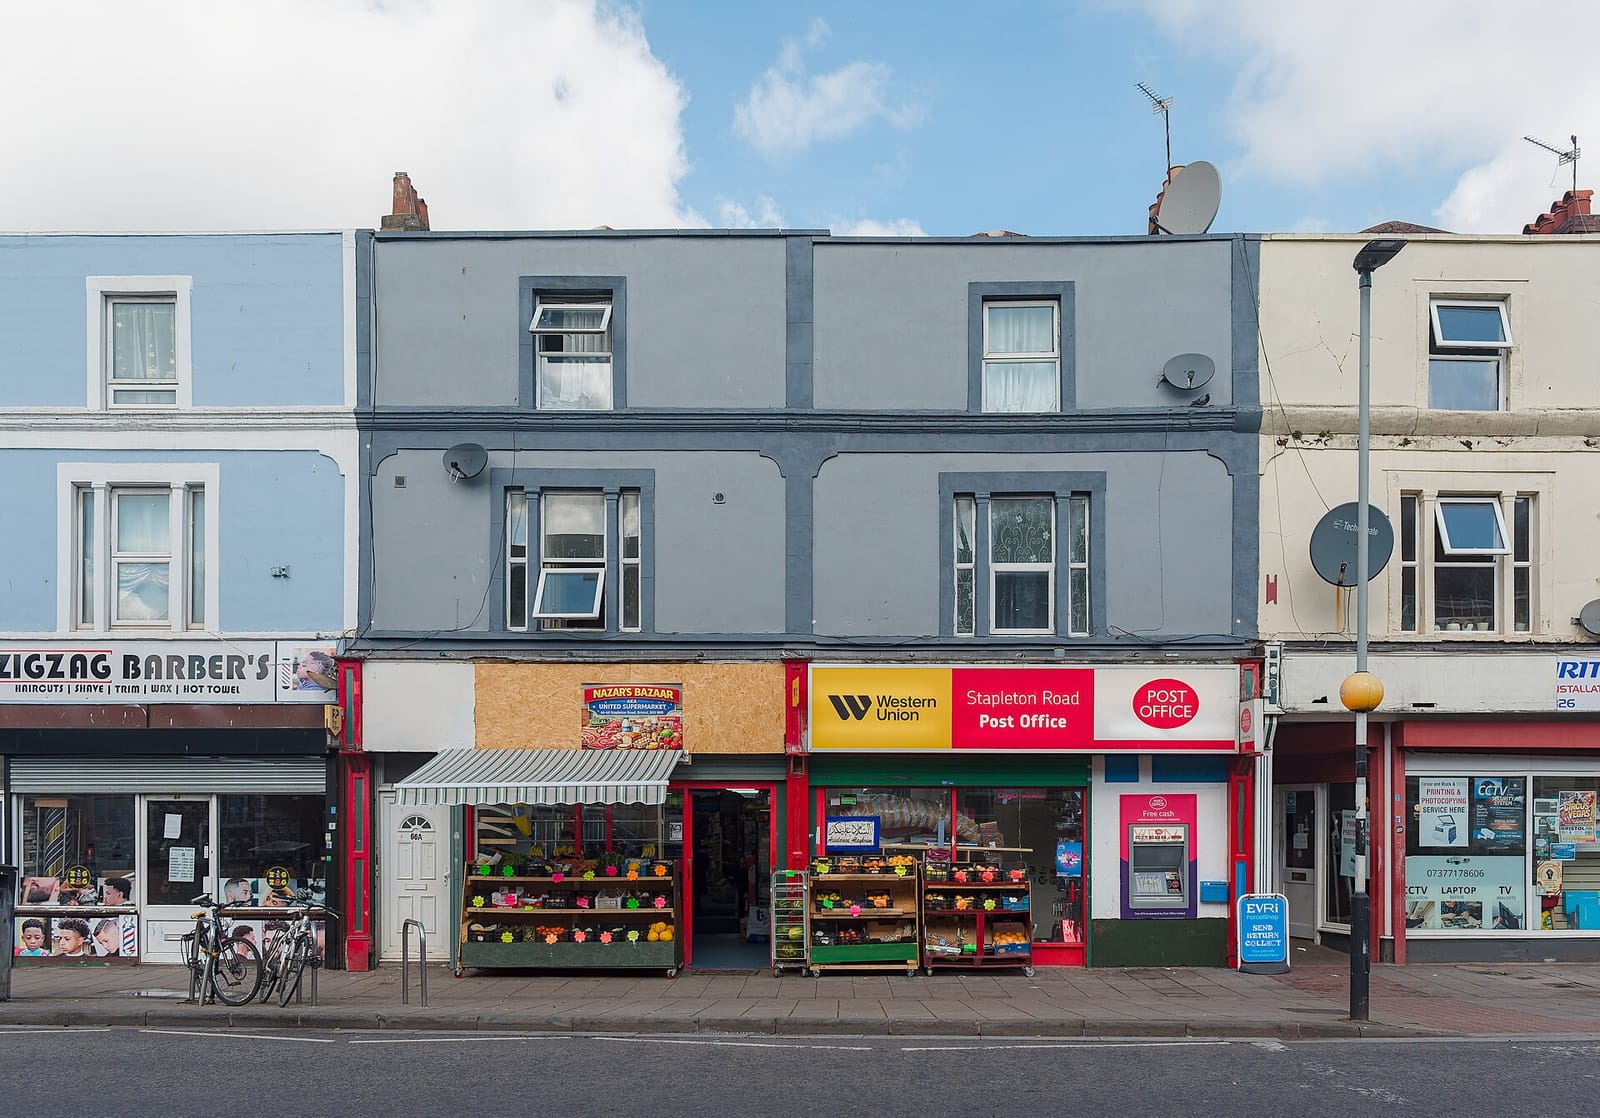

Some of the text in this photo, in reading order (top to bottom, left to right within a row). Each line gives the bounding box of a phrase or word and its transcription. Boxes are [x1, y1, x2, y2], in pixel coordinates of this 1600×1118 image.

[0, 654, 269, 680] ZIGZAG BARBER'S
[1557, 662, 1600, 678] RIT
[15, 684, 240, 694] HAIRCUTS SHAVE TRIM WAX HOT TOWEL
[593, 688, 674, 699] NAZAR'S BAZAAR
[876, 695, 936, 708] Western
[966, 690, 1080, 708] Stapleton Road
[1148, 690, 1188, 702] POST
[876, 708, 919, 720] Union
[1140, 705, 1192, 718] OFFICE
[980, 714, 1066, 728] Post Office
[1478, 785, 1508, 796] CCTV
[1564, 802, 1589, 810] CIRCUS
[1568, 810, 1590, 819] VEGAS
